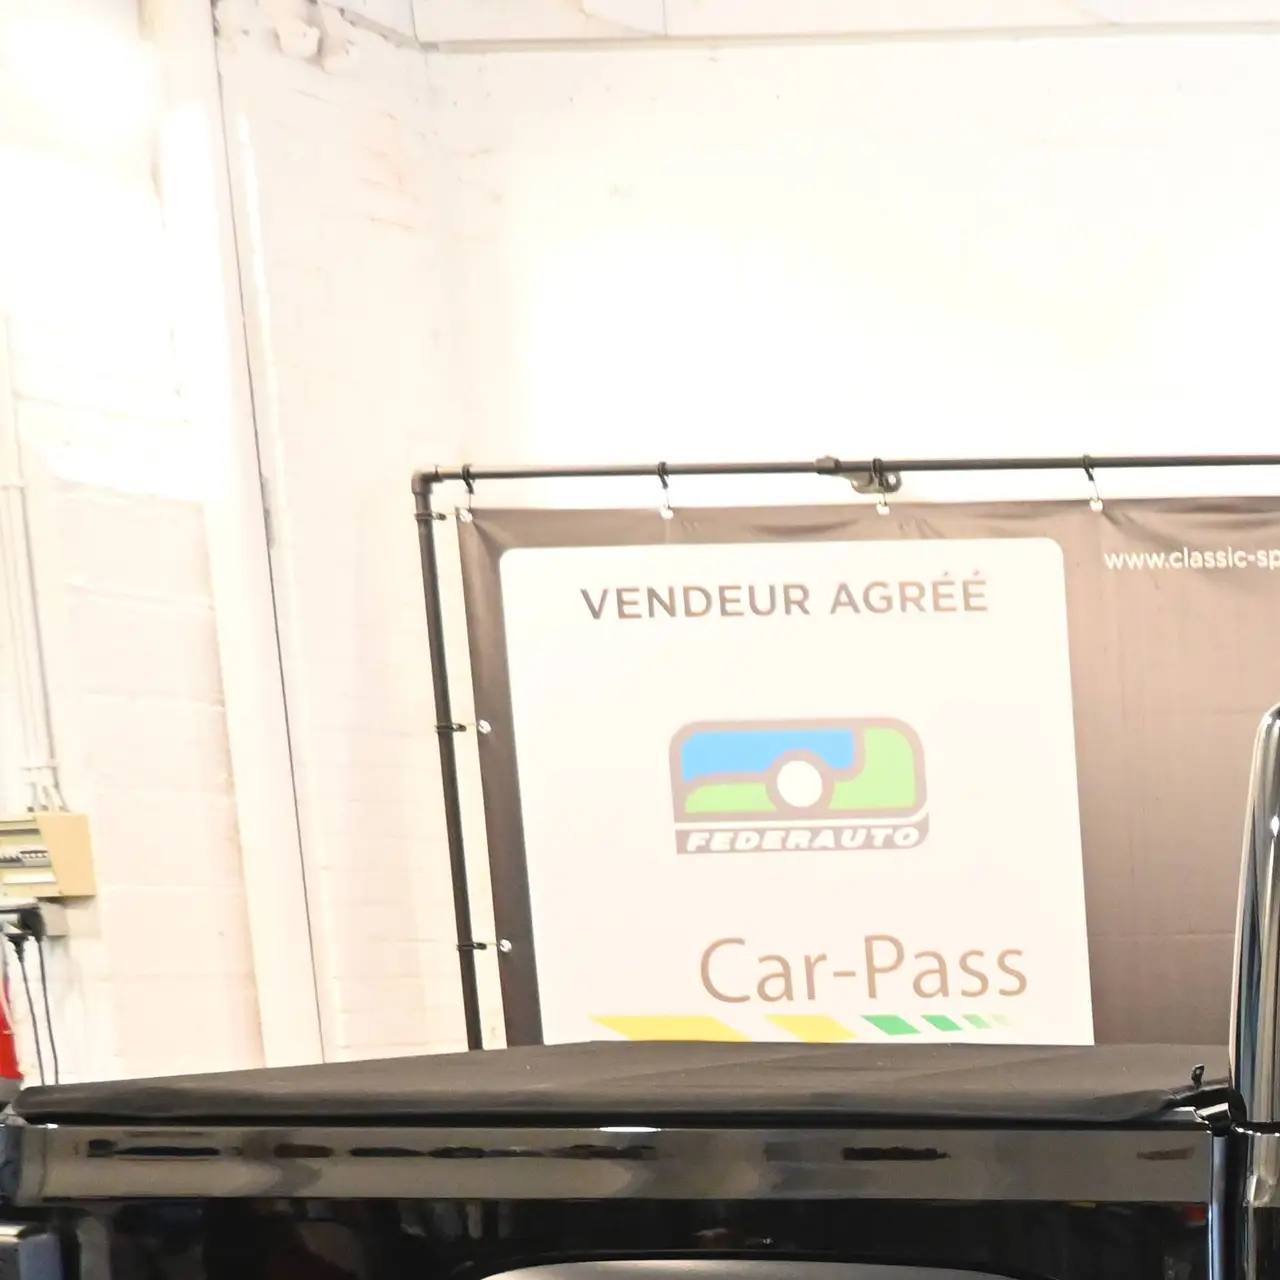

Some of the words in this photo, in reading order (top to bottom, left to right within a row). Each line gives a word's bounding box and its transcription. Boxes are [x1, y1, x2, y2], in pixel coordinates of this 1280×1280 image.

[580, 581, 811, 621] VENDEUR
[830, 569, 990, 616] AGRÉÉ
[684, 826, 921, 854] FEDERAUTO
[699, 934, 1028, 1004] Car-Pass
